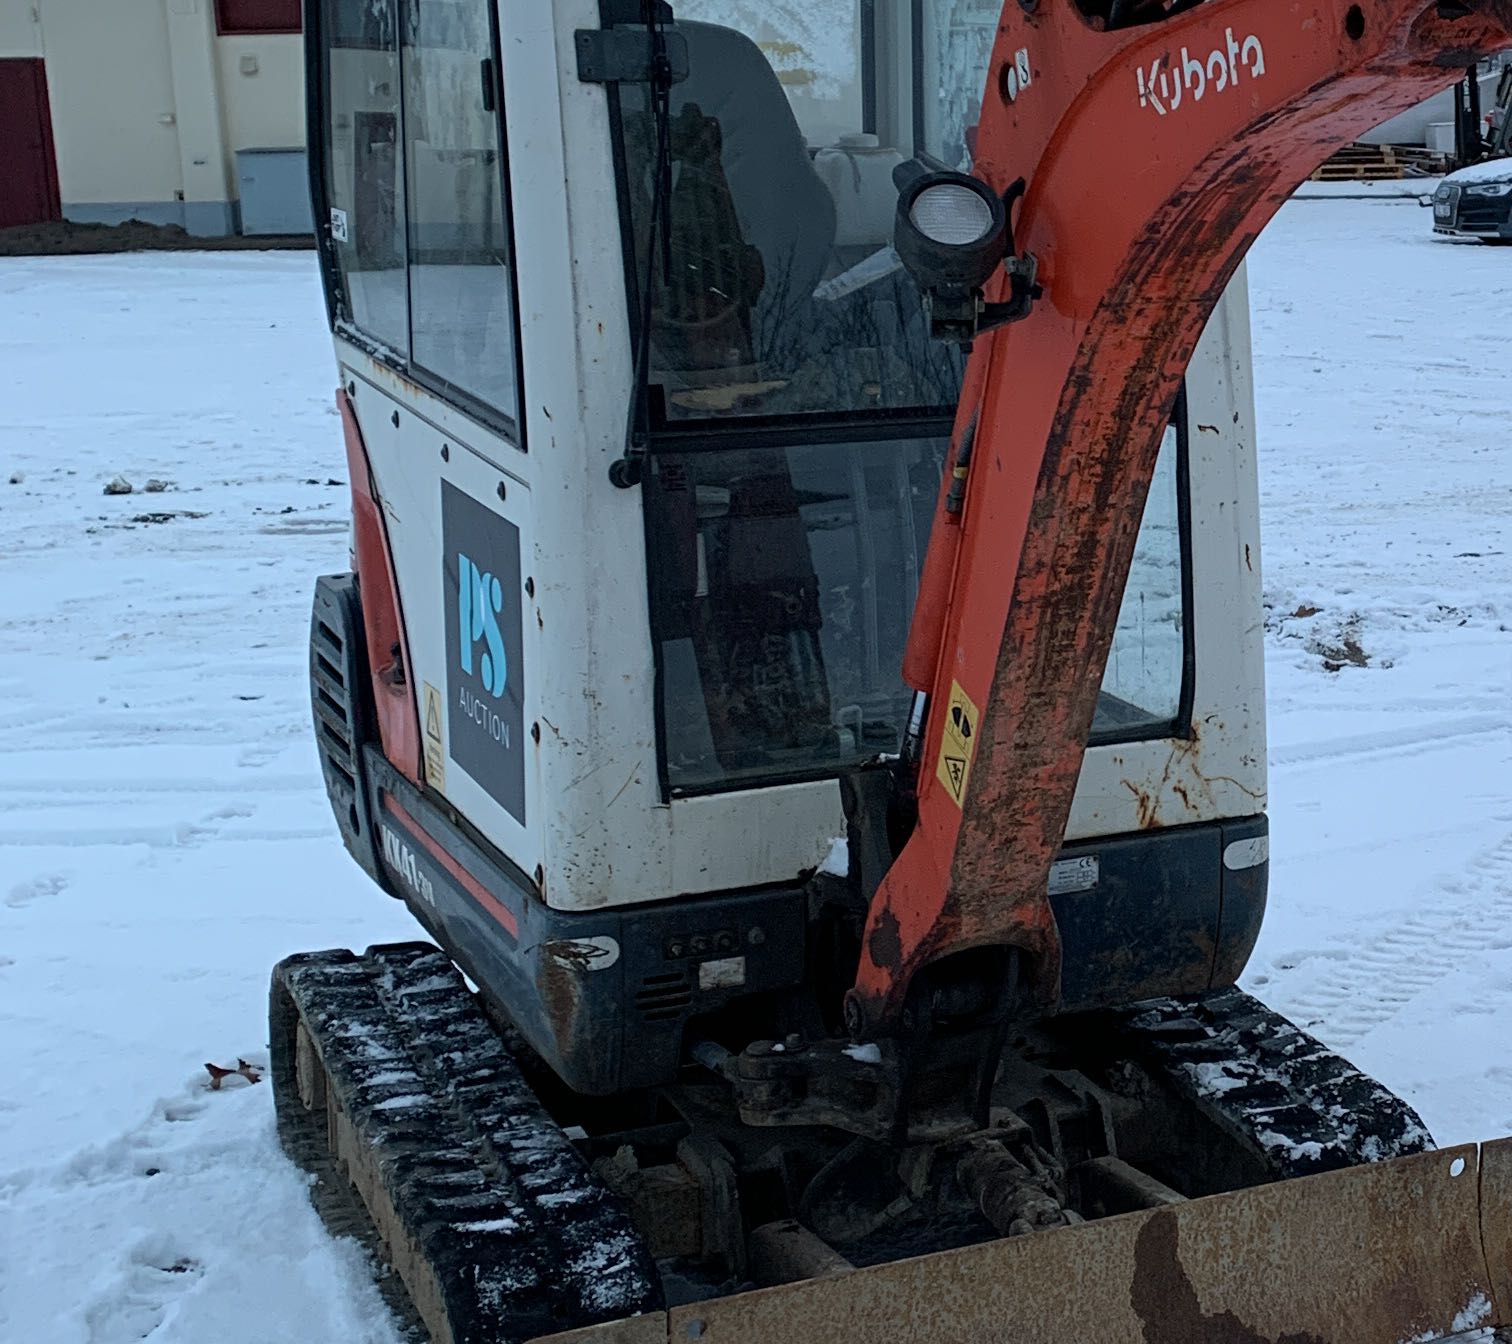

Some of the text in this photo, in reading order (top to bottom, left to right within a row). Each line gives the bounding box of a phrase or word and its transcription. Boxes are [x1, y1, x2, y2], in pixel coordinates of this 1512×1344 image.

[1136, 27, 1265, 115] Kubota
[458, 553, 507, 698] PS
[460, 687, 510, 749] AUCTION
